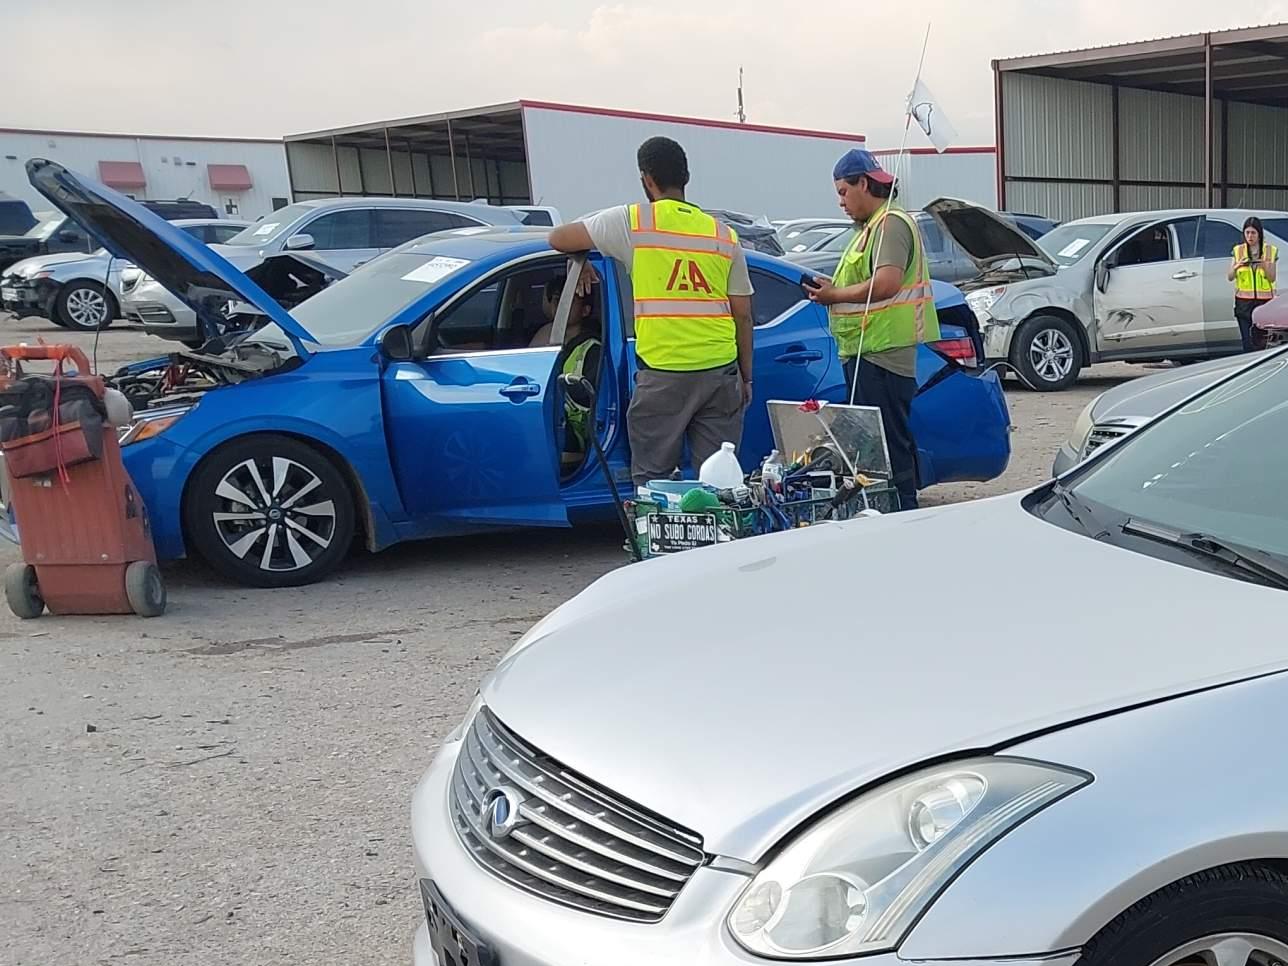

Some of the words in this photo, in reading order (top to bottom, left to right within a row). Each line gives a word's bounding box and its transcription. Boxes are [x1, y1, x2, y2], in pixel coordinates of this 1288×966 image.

[650, 524, 661, 539] NO
[664, 524, 684, 539] SUBO
[687, 524, 715, 541] GORDAS
